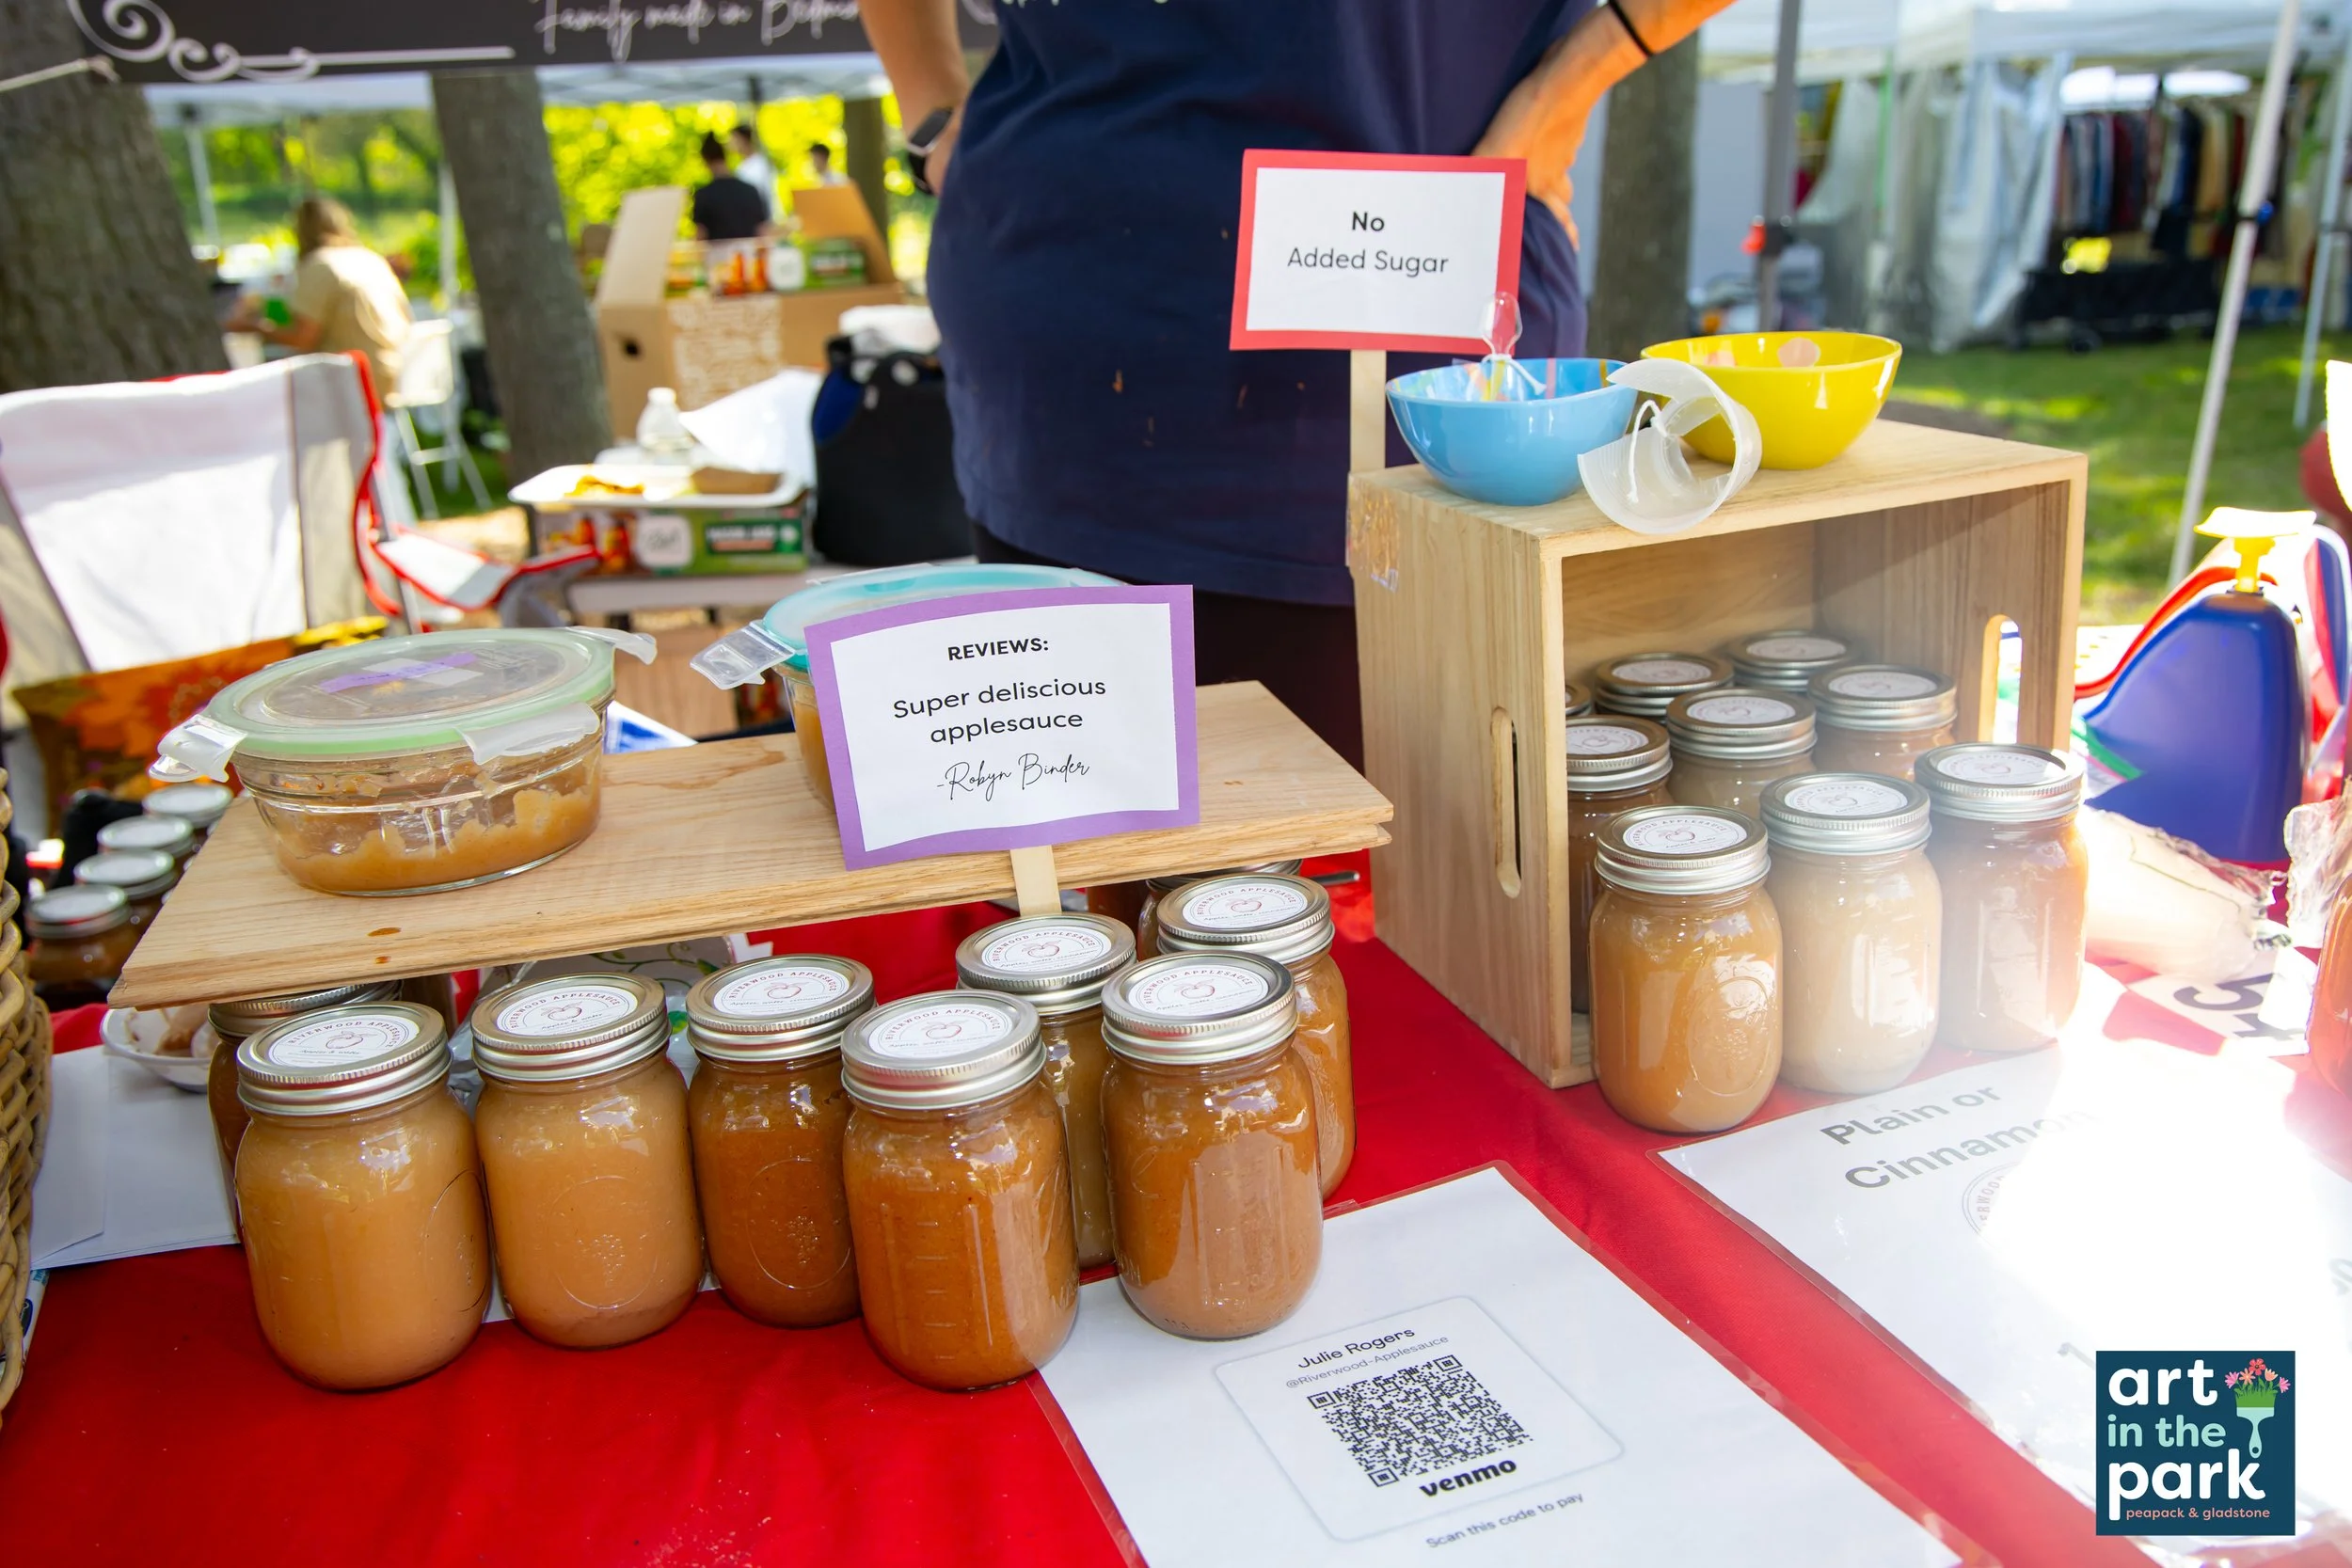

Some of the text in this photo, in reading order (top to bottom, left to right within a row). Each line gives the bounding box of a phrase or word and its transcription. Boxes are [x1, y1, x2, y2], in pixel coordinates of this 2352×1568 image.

[1351, 211, 1386, 232] No
[1287, 247, 1449, 277] Added Sugar
[947, 637, 1049, 661] REVIEWS:
[893, 678, 1107, 720] Super deliscious
[930, 711, 1084, 745] applesauce
[936, 752, 1090, 802] -Robyn Binder
[1240, 887, 1296, 904] APPLESAUCE
[1036, 931, 1096, 947] APPLESAUCE
[729, 971, 837, 999] RIVERWOOD APPLESAUCE
[1184, 970, 1253, 986] APPLESAUCE
[553, 992, 621, 1006] APPLESAUCE
[288, 1022, 362, 1045] RIVERWOOD
[885, 1008, 1001, 1040] RIVERWOOD APPLESAUCE
[1819, 1086, 2001, 1146] Plain or
[1285, 1336, 1450, 1389] @Riverwood-Applesauce
[1297, 1328, 1416, 1369] Julie Rogers
[1419, 1459, 1518, 1497] venmo
[1426, 1493, 1583, 1548] Scan this code to pay
